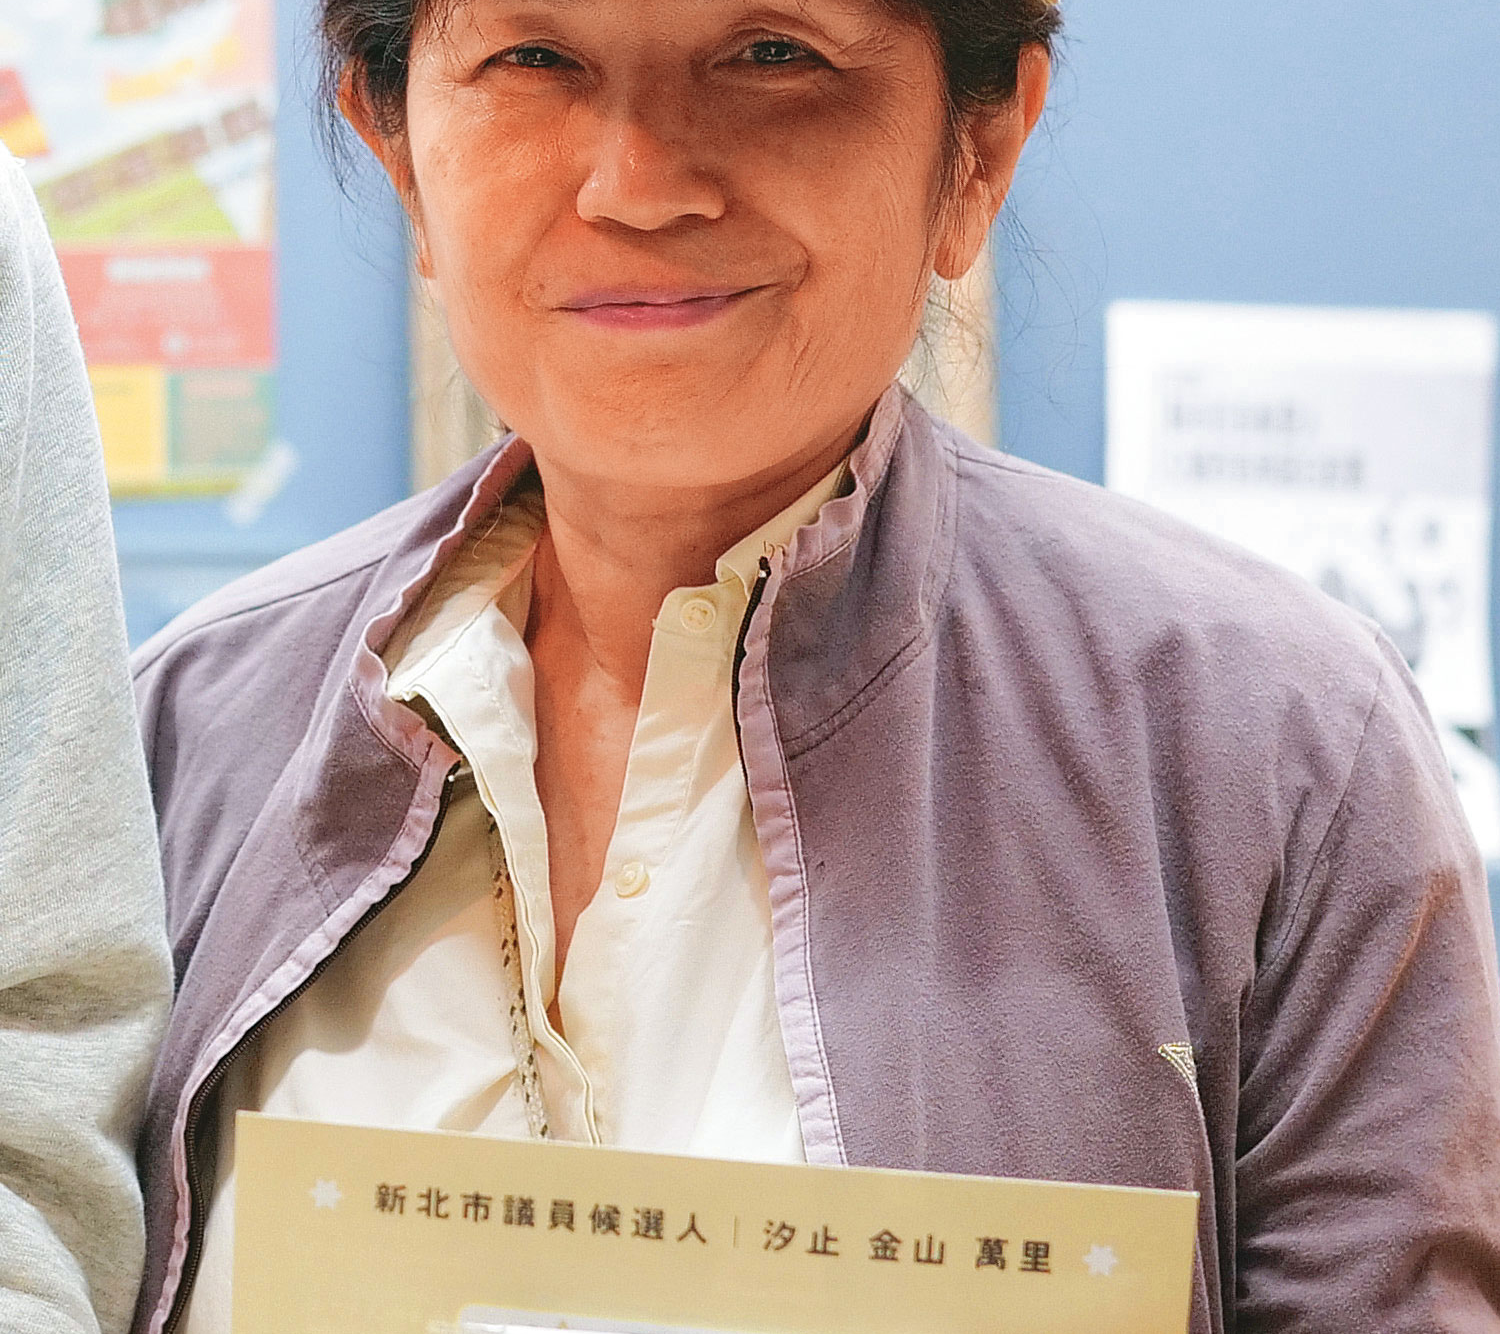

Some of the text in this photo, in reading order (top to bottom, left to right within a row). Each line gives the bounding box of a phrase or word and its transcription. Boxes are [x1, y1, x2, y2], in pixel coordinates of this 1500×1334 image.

[373, 1183, 1053, 1275] 新北市議員候選人 汐止 金山 萬里
